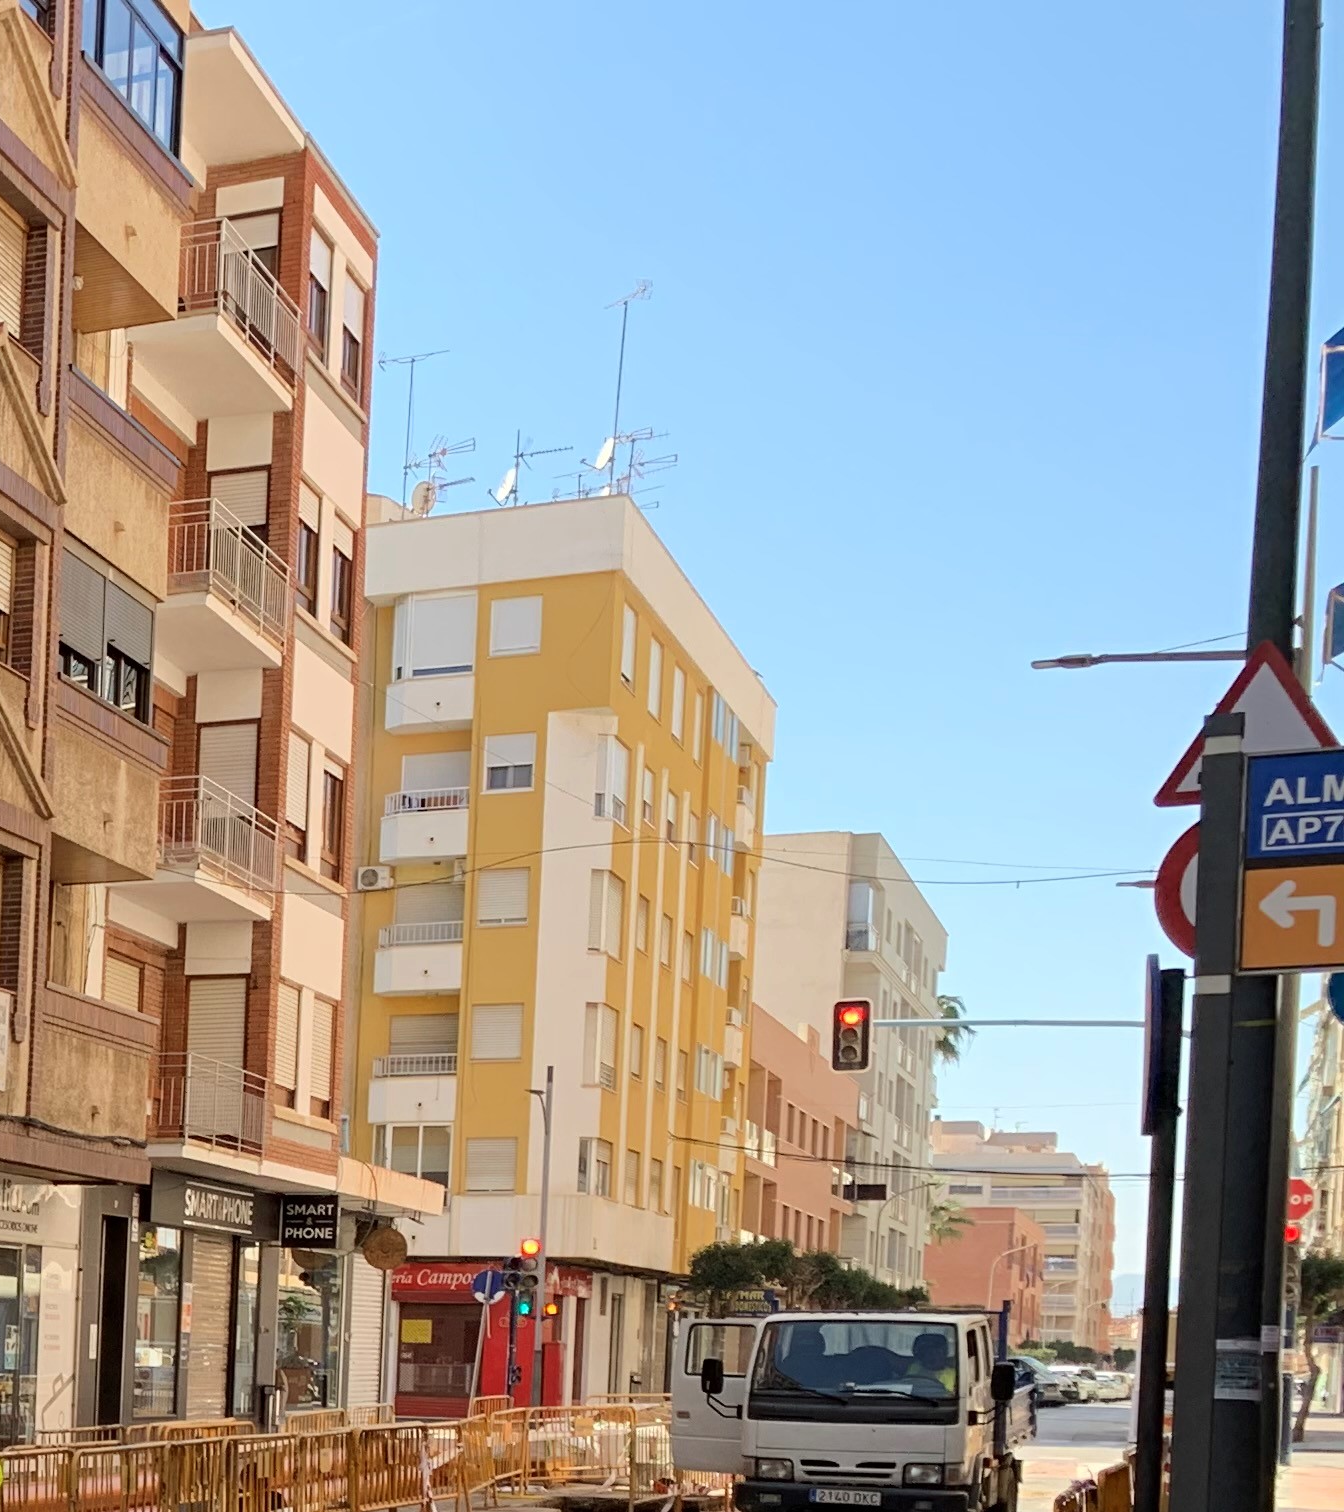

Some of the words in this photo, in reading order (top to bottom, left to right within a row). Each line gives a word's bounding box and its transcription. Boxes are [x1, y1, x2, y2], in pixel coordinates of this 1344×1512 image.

[1289, 1193, 1314, 1205] OP
[286, 1204, 334, 1216] SMART
[285, 1227, 333, 1239] PHONE
[818, 1490, 850, 1502] 2140
